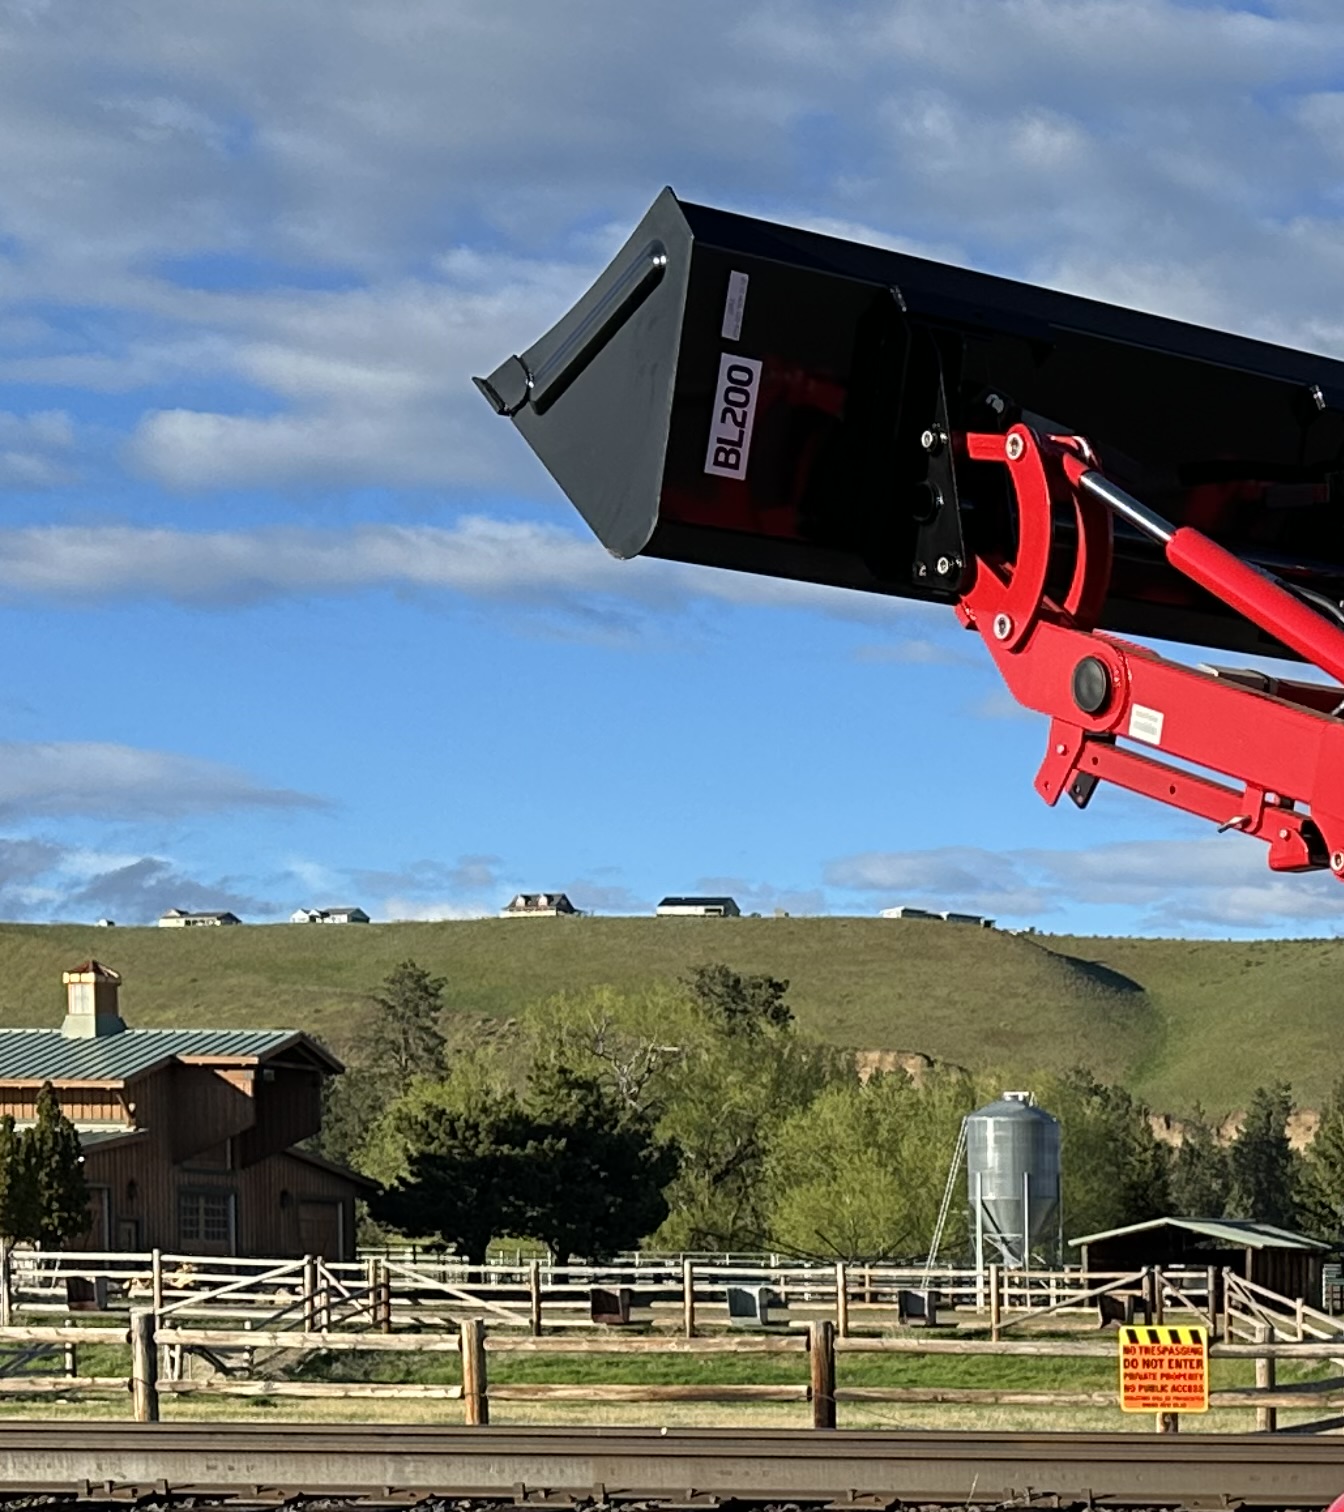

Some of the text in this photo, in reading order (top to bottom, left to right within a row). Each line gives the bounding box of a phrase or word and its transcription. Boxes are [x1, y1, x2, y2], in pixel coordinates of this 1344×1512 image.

[712, 363, 754, 471] BL200
[1123, 1345, 1204, 1356] NO TRESPASSING
[1123, 1358, 1204, 1370] DO NOT ENTER
[1123, 1372, 1204, 1381] PRIVATE PROPERTY
[1124, 1384, 1205, 1393] NO PUBLIC ACCESS
